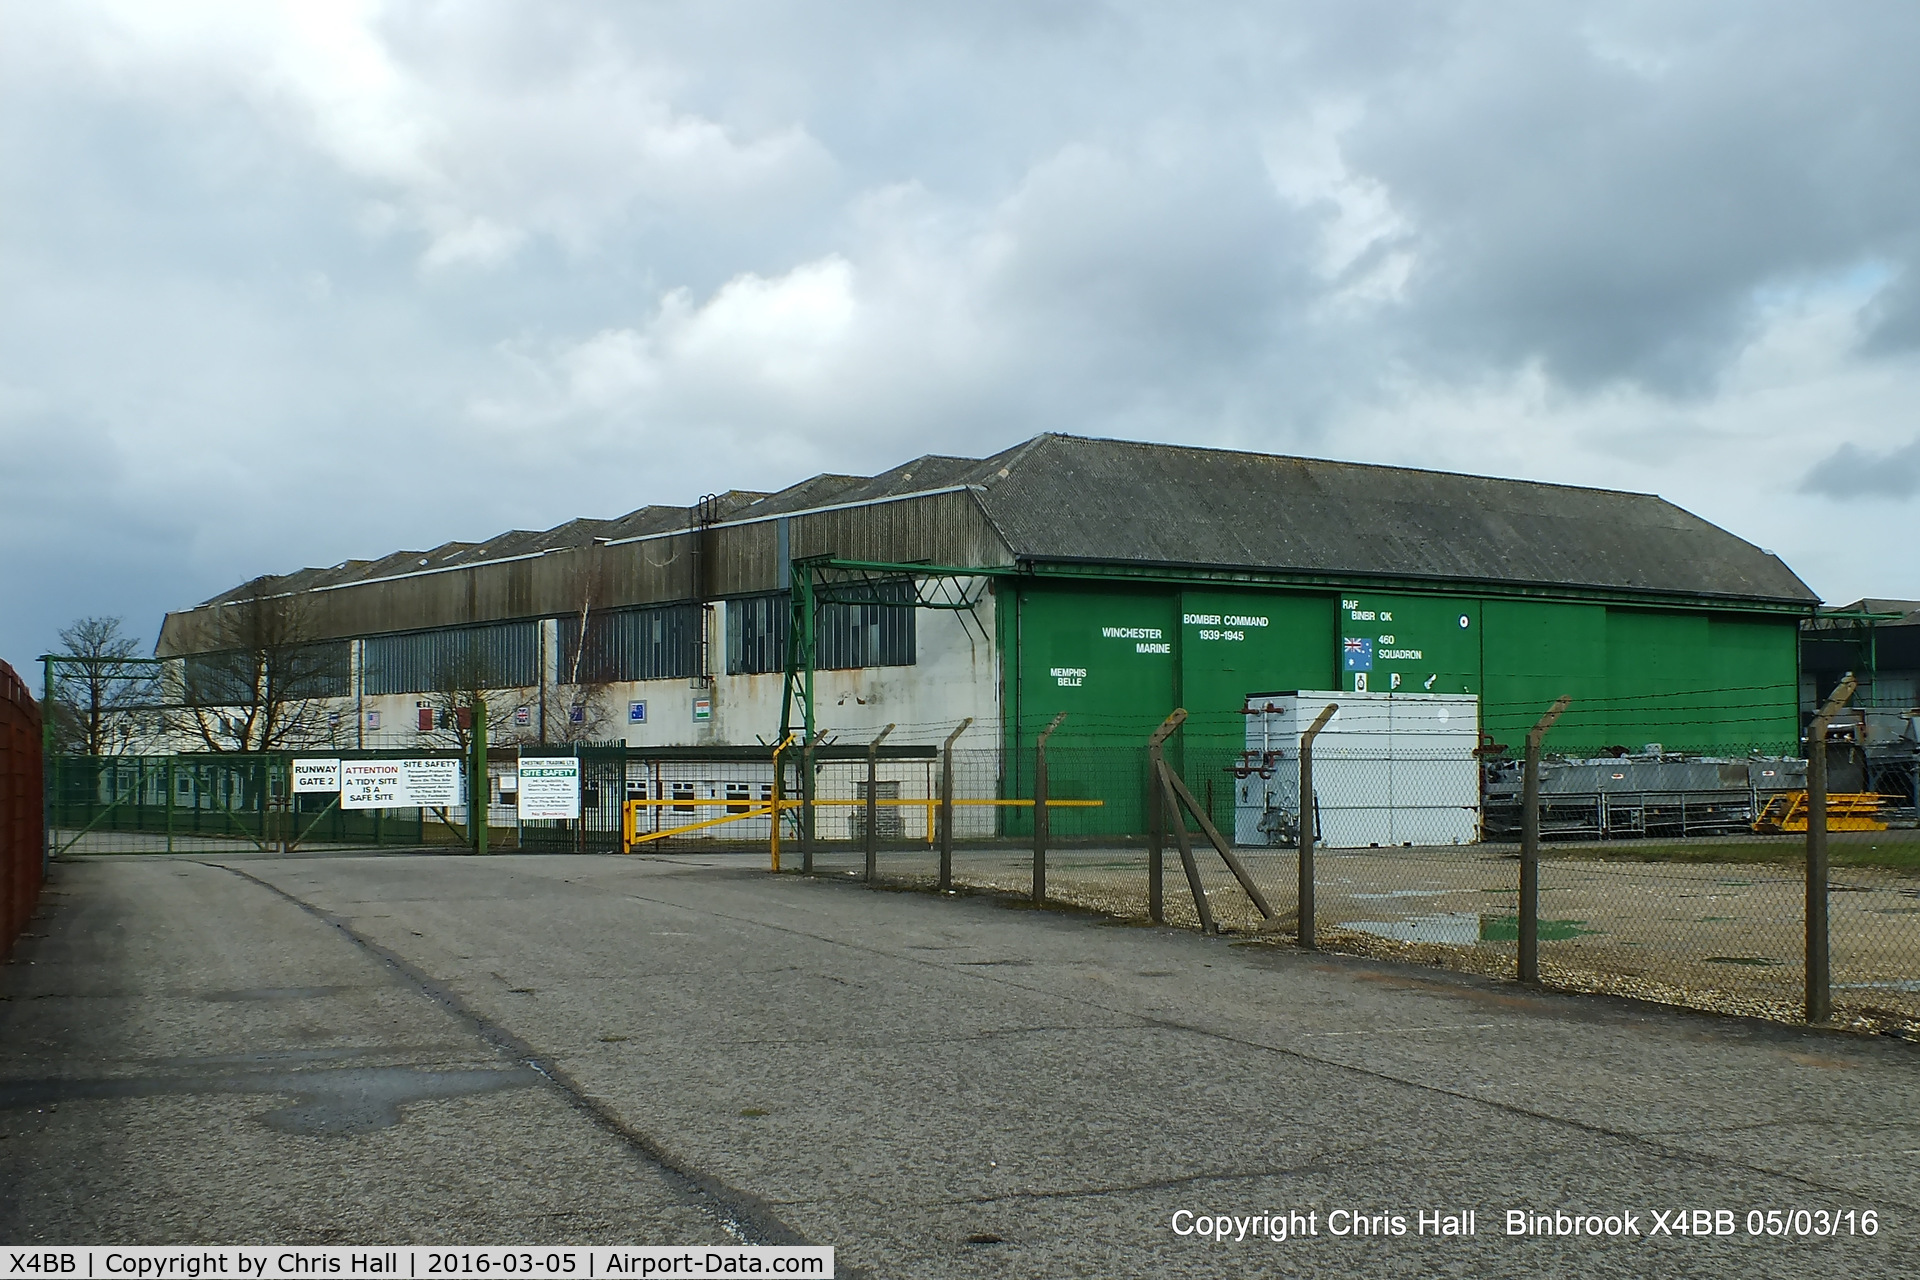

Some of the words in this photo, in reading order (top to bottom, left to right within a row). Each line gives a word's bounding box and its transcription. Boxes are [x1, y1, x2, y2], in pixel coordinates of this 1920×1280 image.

[1342, 600, 1359, 609] RAF
[1183, 613, 1221, 625] BOMBER
[1223, 615, 1269, 627] COMMAND
[1380, 611, 1393, 622] OK
[1102, 627, 1162, 639] WINCHESTER
[1199, 629, 1245, 641] 1939-1945
[1378, 634, 1395, 645] 460
[1136, 642, 1171, 654] MARINE
[1378, 648, 1422, 660] SQUADRON
[1050, 667, 1087, 678] MEMPHIS
[1057, 677, 1083, 687] BELLE
[424, 760, 457, 768] SAFETY
[294, 765, 338, 774] RUNWAY
[345, 766, 399, 774] ATTENTION
[522, 769, 541, 777] SITE
[542, 769, 574, 777] SAFETY
[299, 777, 326, 786] GATE
[327, 777, 335, 785] 2
[355, 778, 376, 786] TIDY
[378, 777, 398, 785] SITE
[349, 794, 372, 802] SAFE
[374, 793, 394, 801] SITE
